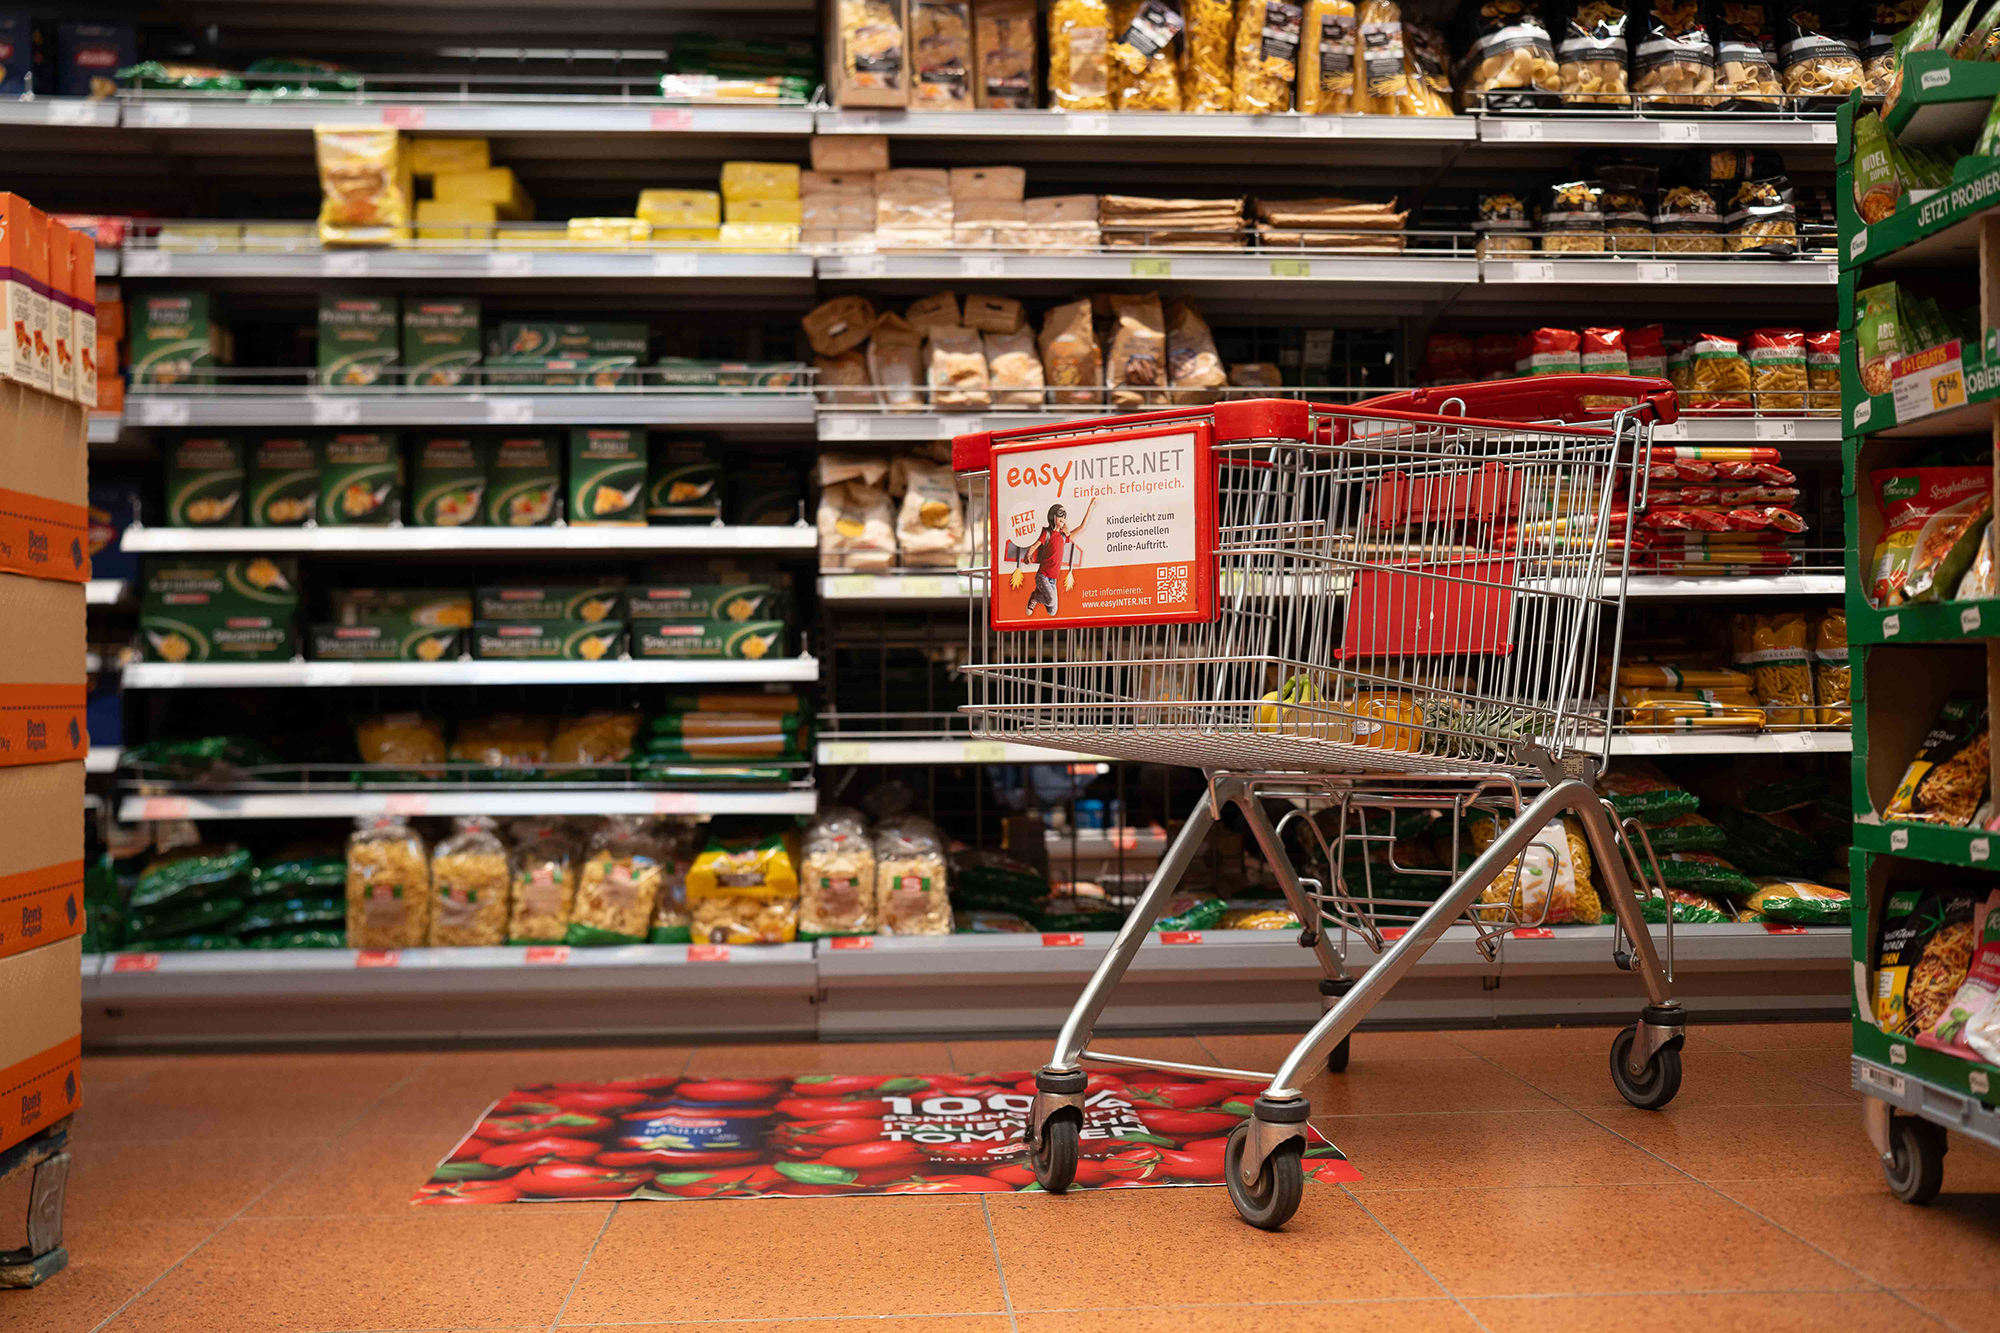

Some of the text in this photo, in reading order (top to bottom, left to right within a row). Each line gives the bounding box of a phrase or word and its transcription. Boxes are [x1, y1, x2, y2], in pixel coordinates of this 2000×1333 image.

[1917, 194, 1950, 227] JETZT
[1877, 322, 1895, 340] ABC
[1964, 366, 2000, 396] OBIER
[1073, 477, 1185, 498] Einfach. Erfolgreich.
[1929, 476, 1987, 500] Spaghetteria
[1011, 509, 1035, 527] JETZT
[1106, 513, 1175, 525] Kinderleicht zum
[1015, 523, 1036, 537] NEU!
[1106, 526, 1169, 541] professionellen
[1106, 541, 1168, 553] Online-Auftritt.
[1082, 586, 1144, 598] Jetzt informieren:
[1082, 597, 1152, 608] www.easyINTER.NET
[930, 1154, 1014, 1162] MASTERS
